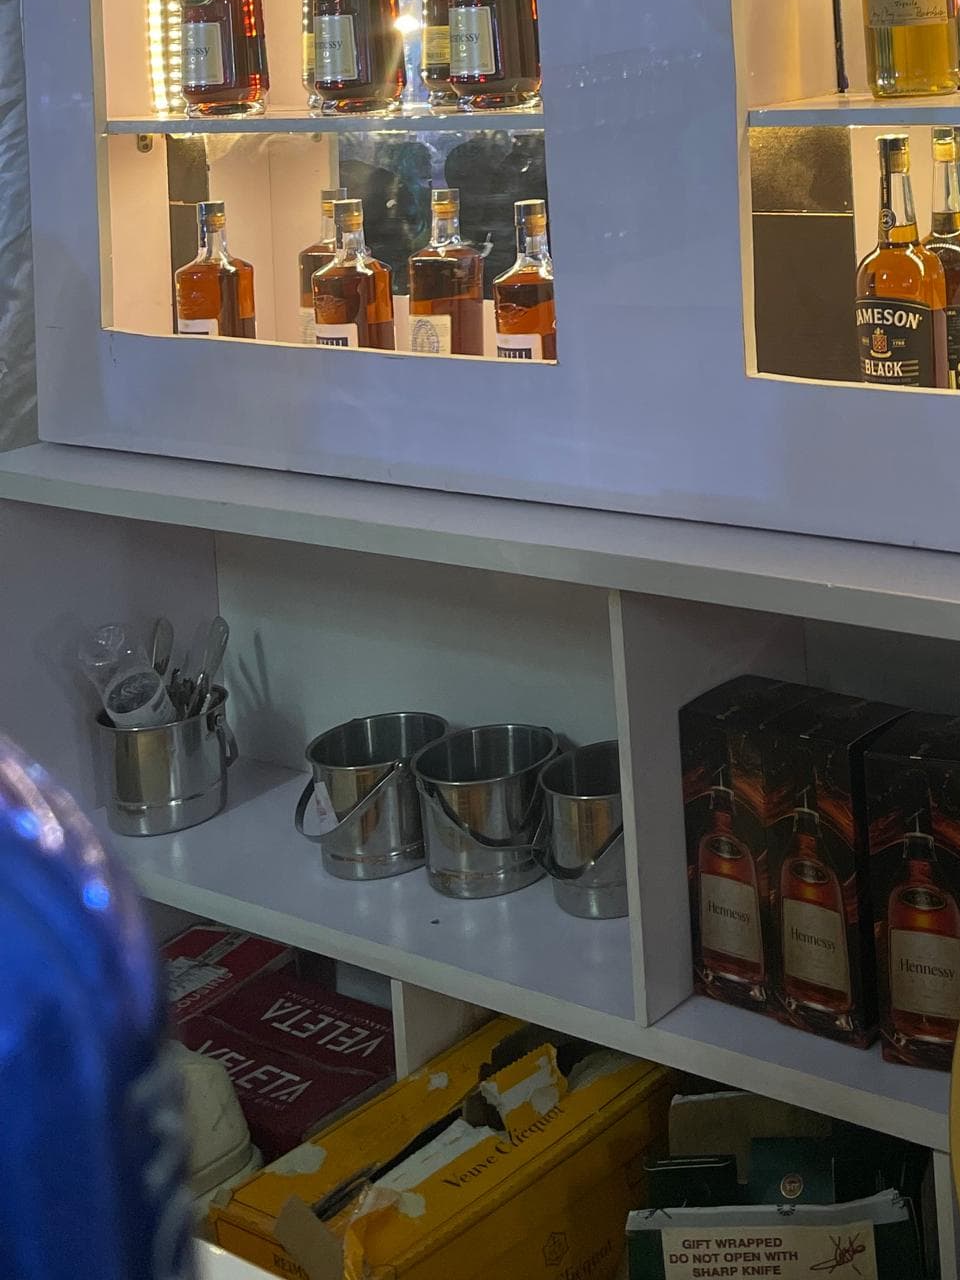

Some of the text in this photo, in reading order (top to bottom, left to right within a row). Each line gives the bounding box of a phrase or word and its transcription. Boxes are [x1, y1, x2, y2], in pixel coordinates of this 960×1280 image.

[864, 359, 903, 377] BLACK
[708, 899, 751, 924] Hennessy
[790, 927, 836, 953] Hennessy
[899, 957, 955, 980] Hennessy
[260, 998, 386, 1058] VELETA
[442, 1152, 498, 1190] Veuve
[682, 1237, 783, 1250] GIFT WRAPPED
[669, 1251, 798, 1265] DO NOT OPEN WITH
[692, 1266, 782, 1278] SHARP KNIFE
